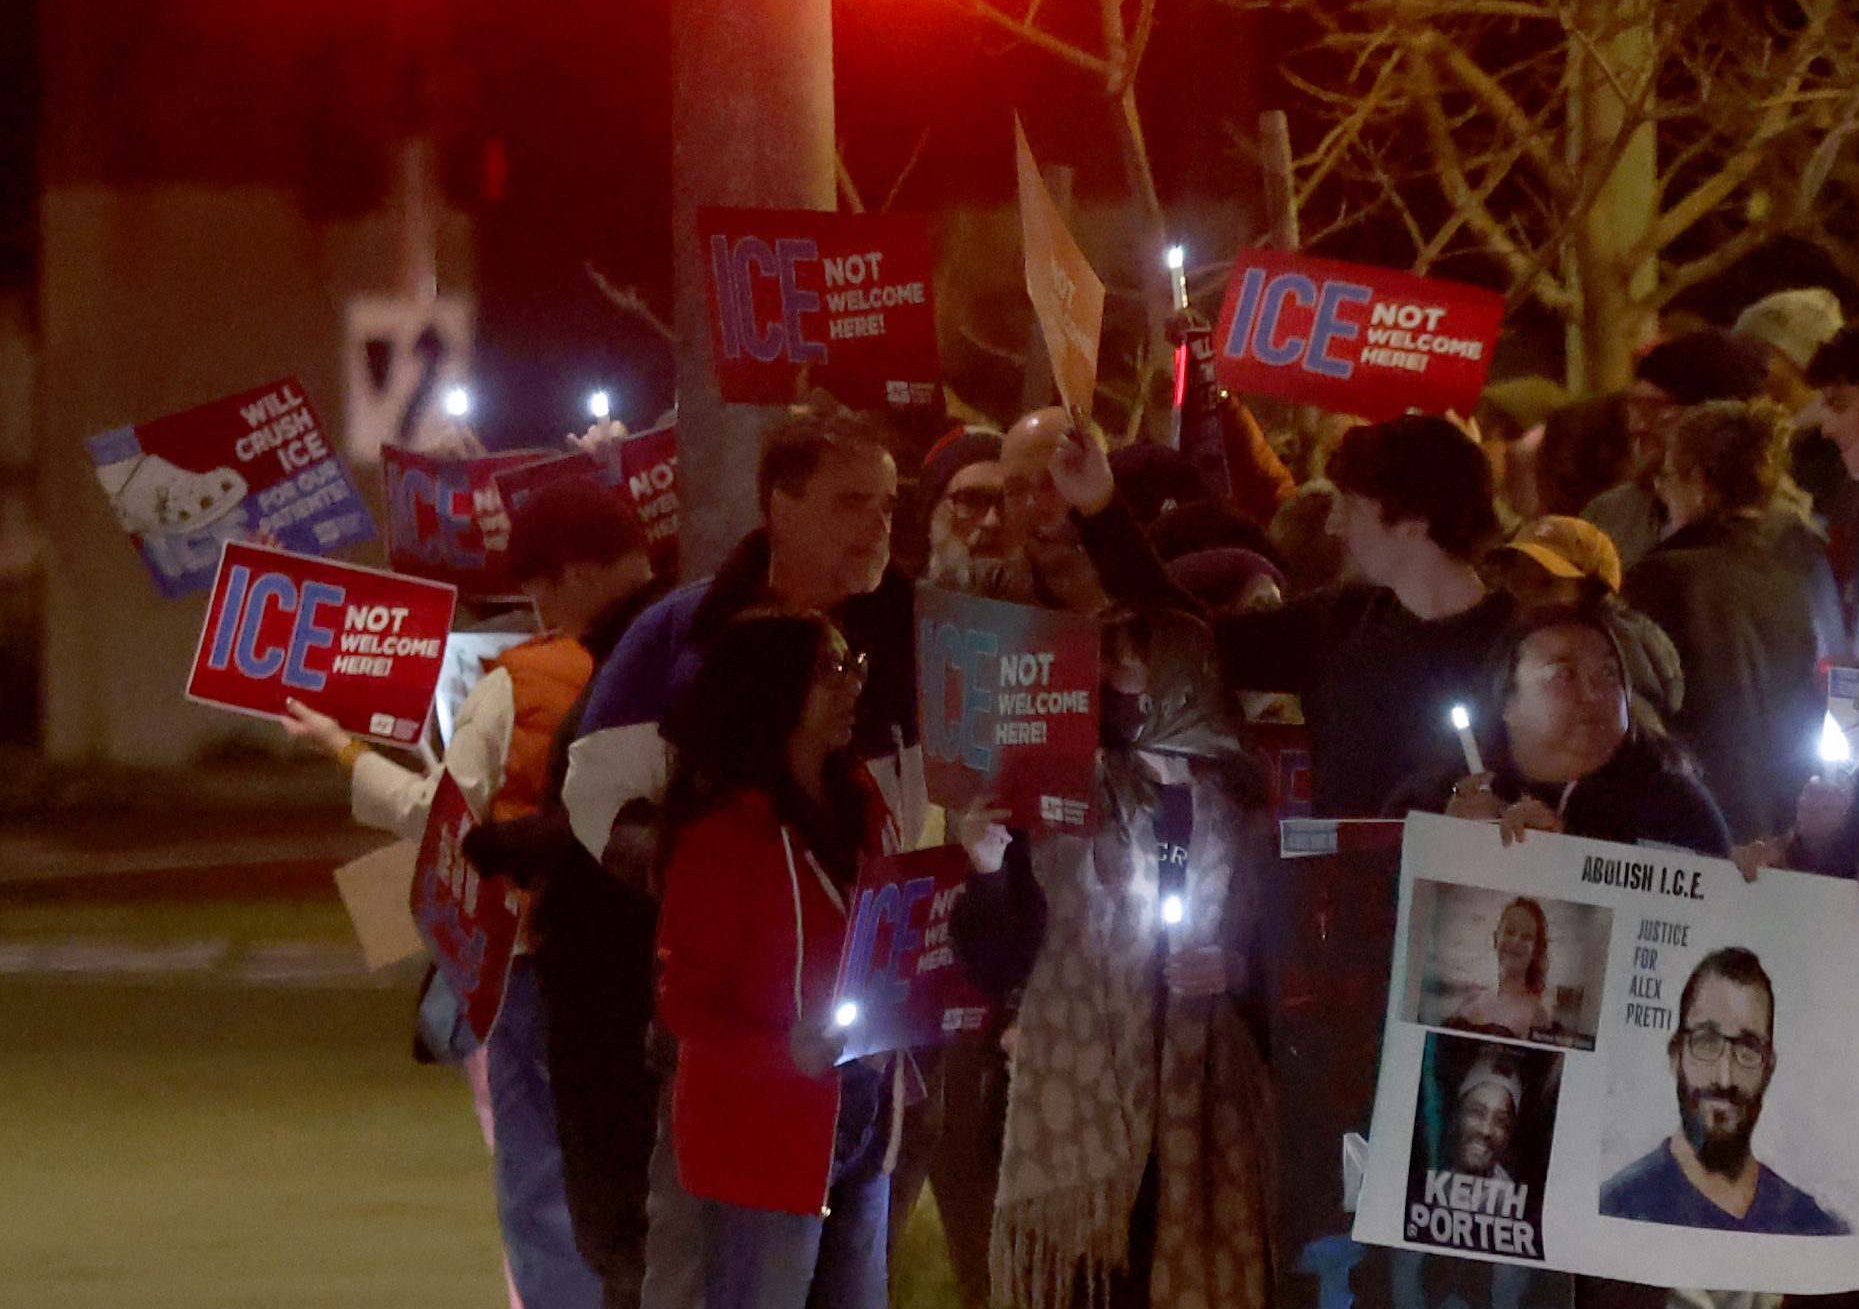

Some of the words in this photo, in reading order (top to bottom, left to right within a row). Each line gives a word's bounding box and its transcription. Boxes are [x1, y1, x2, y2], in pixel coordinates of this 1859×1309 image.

[822, 251, 883, 288] NOT
[710, 233, 829, 365] ICE
[825, 281, 926, 313] WELCOME
[828, 313, 887, 340] HERE!
[1223, 266, 1375, 380] ICE
[1369, 301, 1447, 332] NOT
[1366, 326, 1484, 361] WELCOME
[239, 384, 304, 430] WILL
[234, 407, 316, 463] CRUSH
[276, 429, 329, 474] ICE
[628, 456, 679, 502] NO
[206, 563, 347, 693] ICE
[344, 603, 410, 634] NOT
[339, 633, 442, 659] WELCOME
[331, 654, 395, 678] HERE!
[1000, 652, 1055, 688] NOT
[998, 690, 1090, 717] WELCOME
[994, 720, 1049, 747] HERE!
[1581, 855, 1655, 893] ABOLISH
[1659, 866, 1705, 901] I.C.E.
[1637, 918, 1692, 948] JUSTICE
[1633, 945, 1659, 972] FOR
[1629, 974, 1663, 1001] ALEX
[1625, 1003, 1673, 1031] PRETTI
[1423, 1168, 1530, 1221] KEITH
[1409, 1202, 1538, 1258] PORTER
